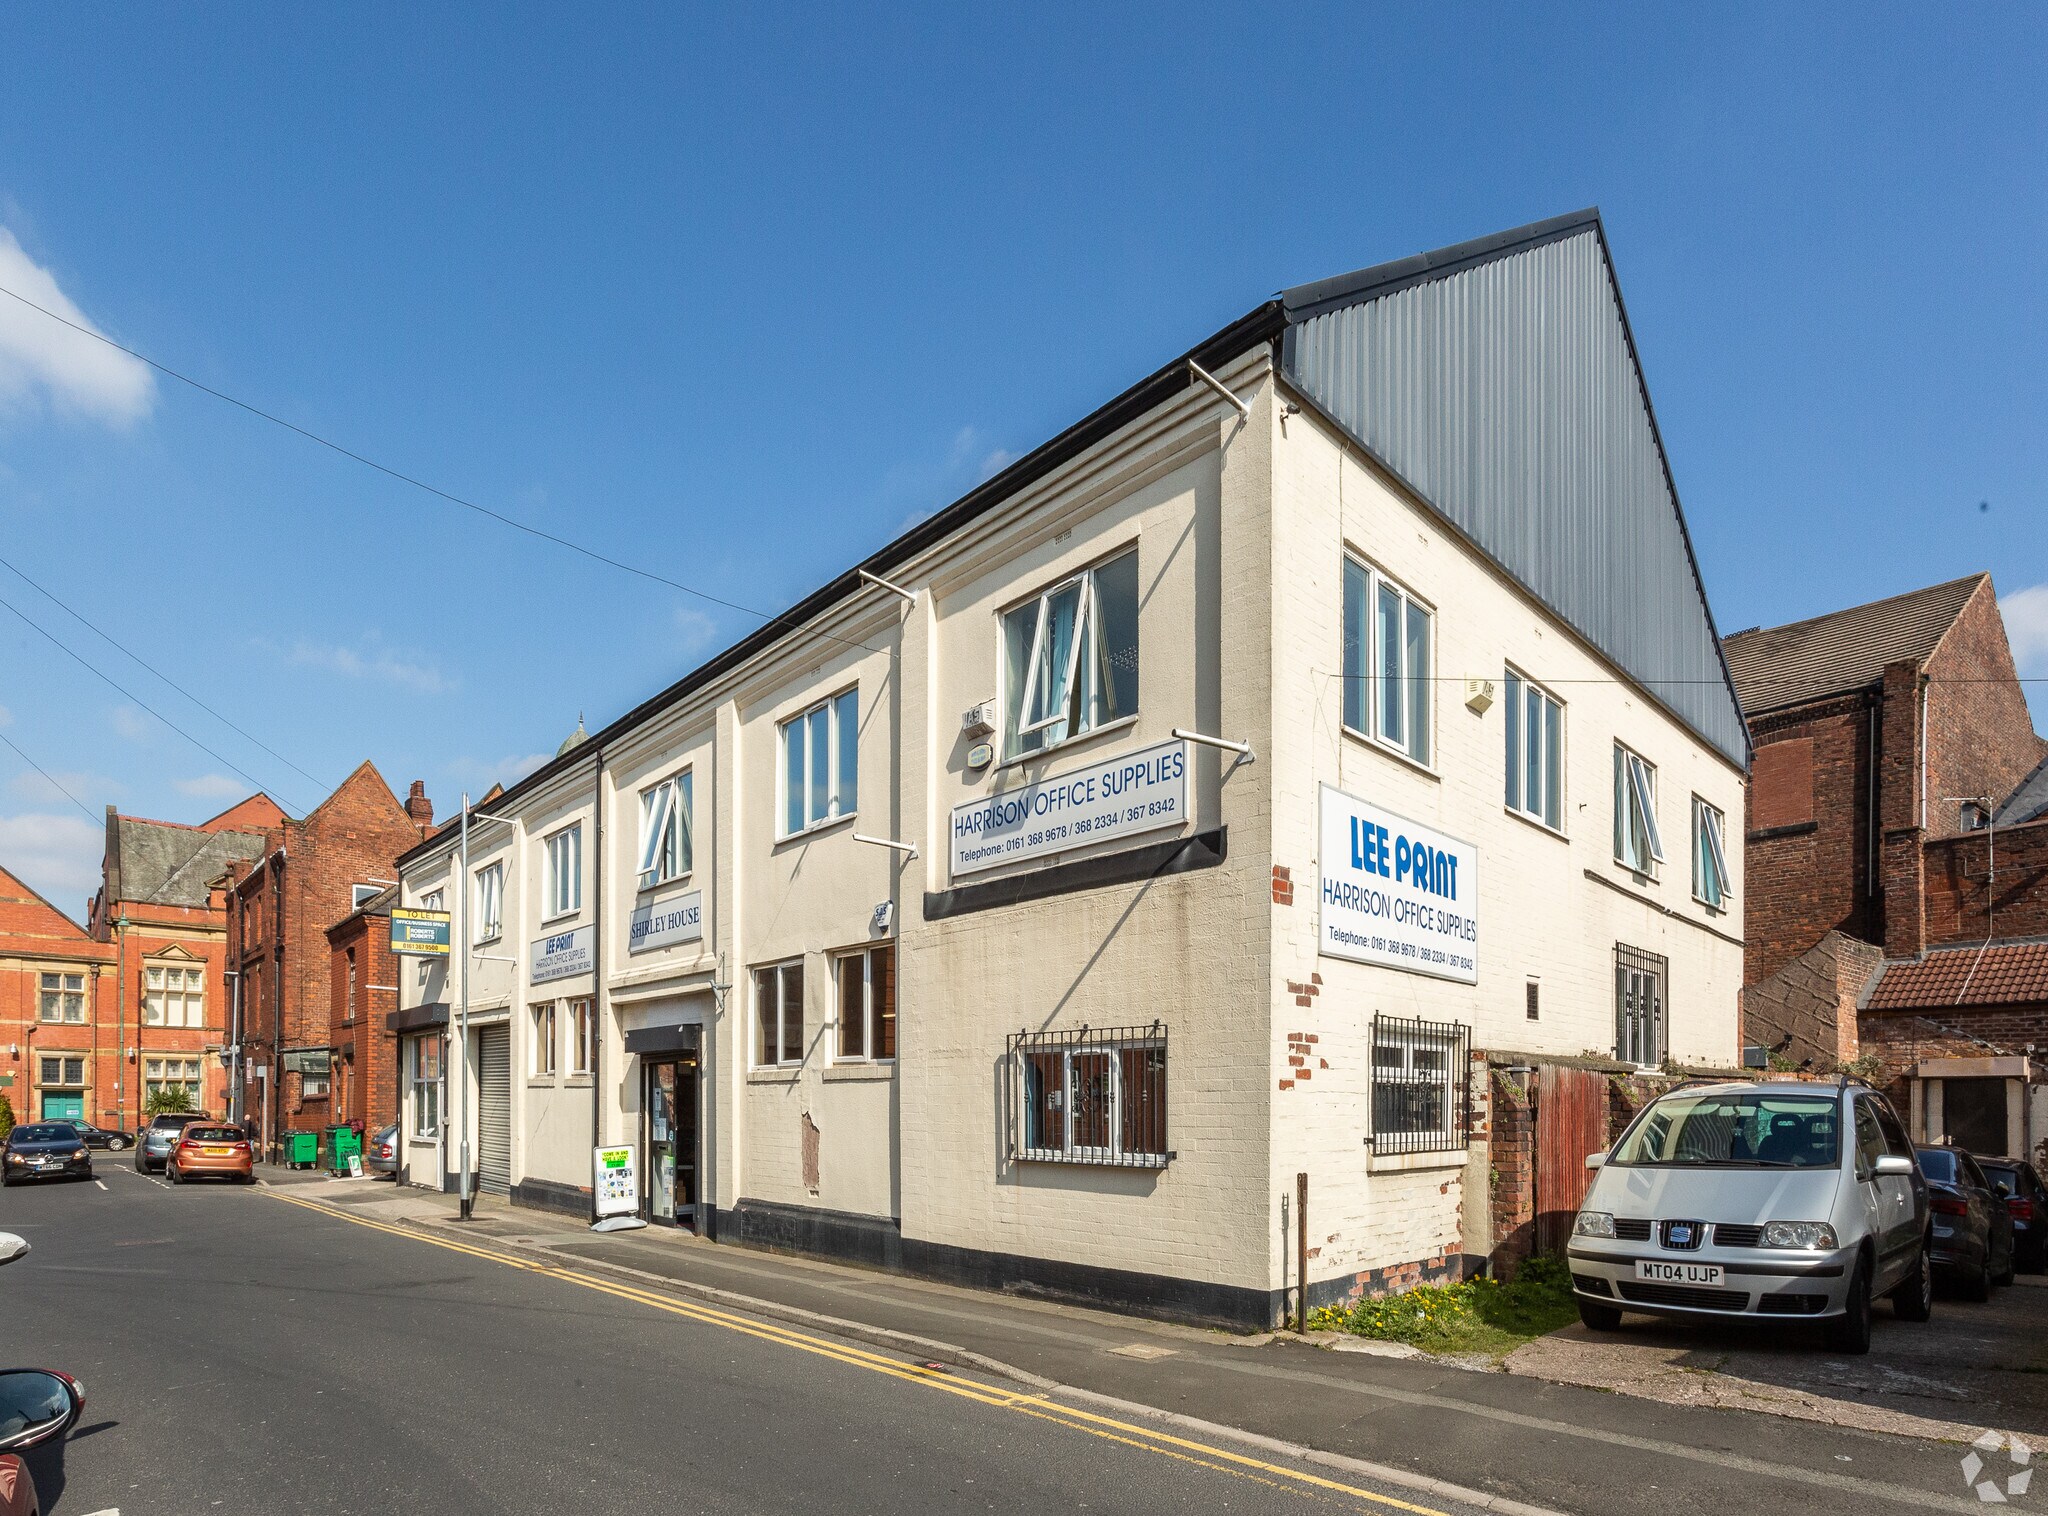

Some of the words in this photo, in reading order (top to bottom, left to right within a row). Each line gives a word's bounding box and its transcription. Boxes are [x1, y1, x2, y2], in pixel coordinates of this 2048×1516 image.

[955, 796, 1030, 838] HARRISON
[1034, 778, 1095, 815] OFFICE
[1101, 752, 1183, 797] SUPPLIES
[960, 843, 1004, 862] Telephone:
[1006, 834, 1025, 851] 0161
[1027, 830, 1043, 847] 368
[1045, 825, 1067, 843] 9678
[1069, 823, 1073, 836] /
[1075, 820, 1092, 835] 368
[1094, 812, 1118, 830] 2334
[1120, 809, 1125, 823] /
[1127, 805, 1145, 821] 367
[1148, 797, 1175, 816] 8342
[1350, 815, 1390, 878] LEE
[1395, 834, 1457, 901] PRINT
[407, 910, 418, 918] TO
[420, 911, 436, 919] LET
[631, 915, 667, 939] SHIRLEY
[668, 906, 700, 930] HOUSE
[1323, 877, 1391, 919] HARRISON
[1394, 898, 1433, 931] OFFICE
[1437, 910, 1476, 942] SUPPLIES
[536, 957, 553, 969] HARRISON
[554, 952, 568, 965] OFFICE
[568, 947, 586, 962] SUPPLIES
[546, 939, 555, 955] LEE
[556, 933, 574, 952] PRINT
[1329, 925, 1370, 947] Telephone:
[1371, 936, 1386, 951] 0161
[1387, 939, 1400, 954] 368
[1401, 942, 1416, 958] 9678
[1420, 947, 1431, 961] 368
[1432, 950, 1446, 964] 2334
[1449, 954, 1460, 967] 367
[1460, 956, 1473, 970] 8342
[1644, 1263, 1683, 1280] MT04
[1688, 1266, 1719, 1283] UJP
